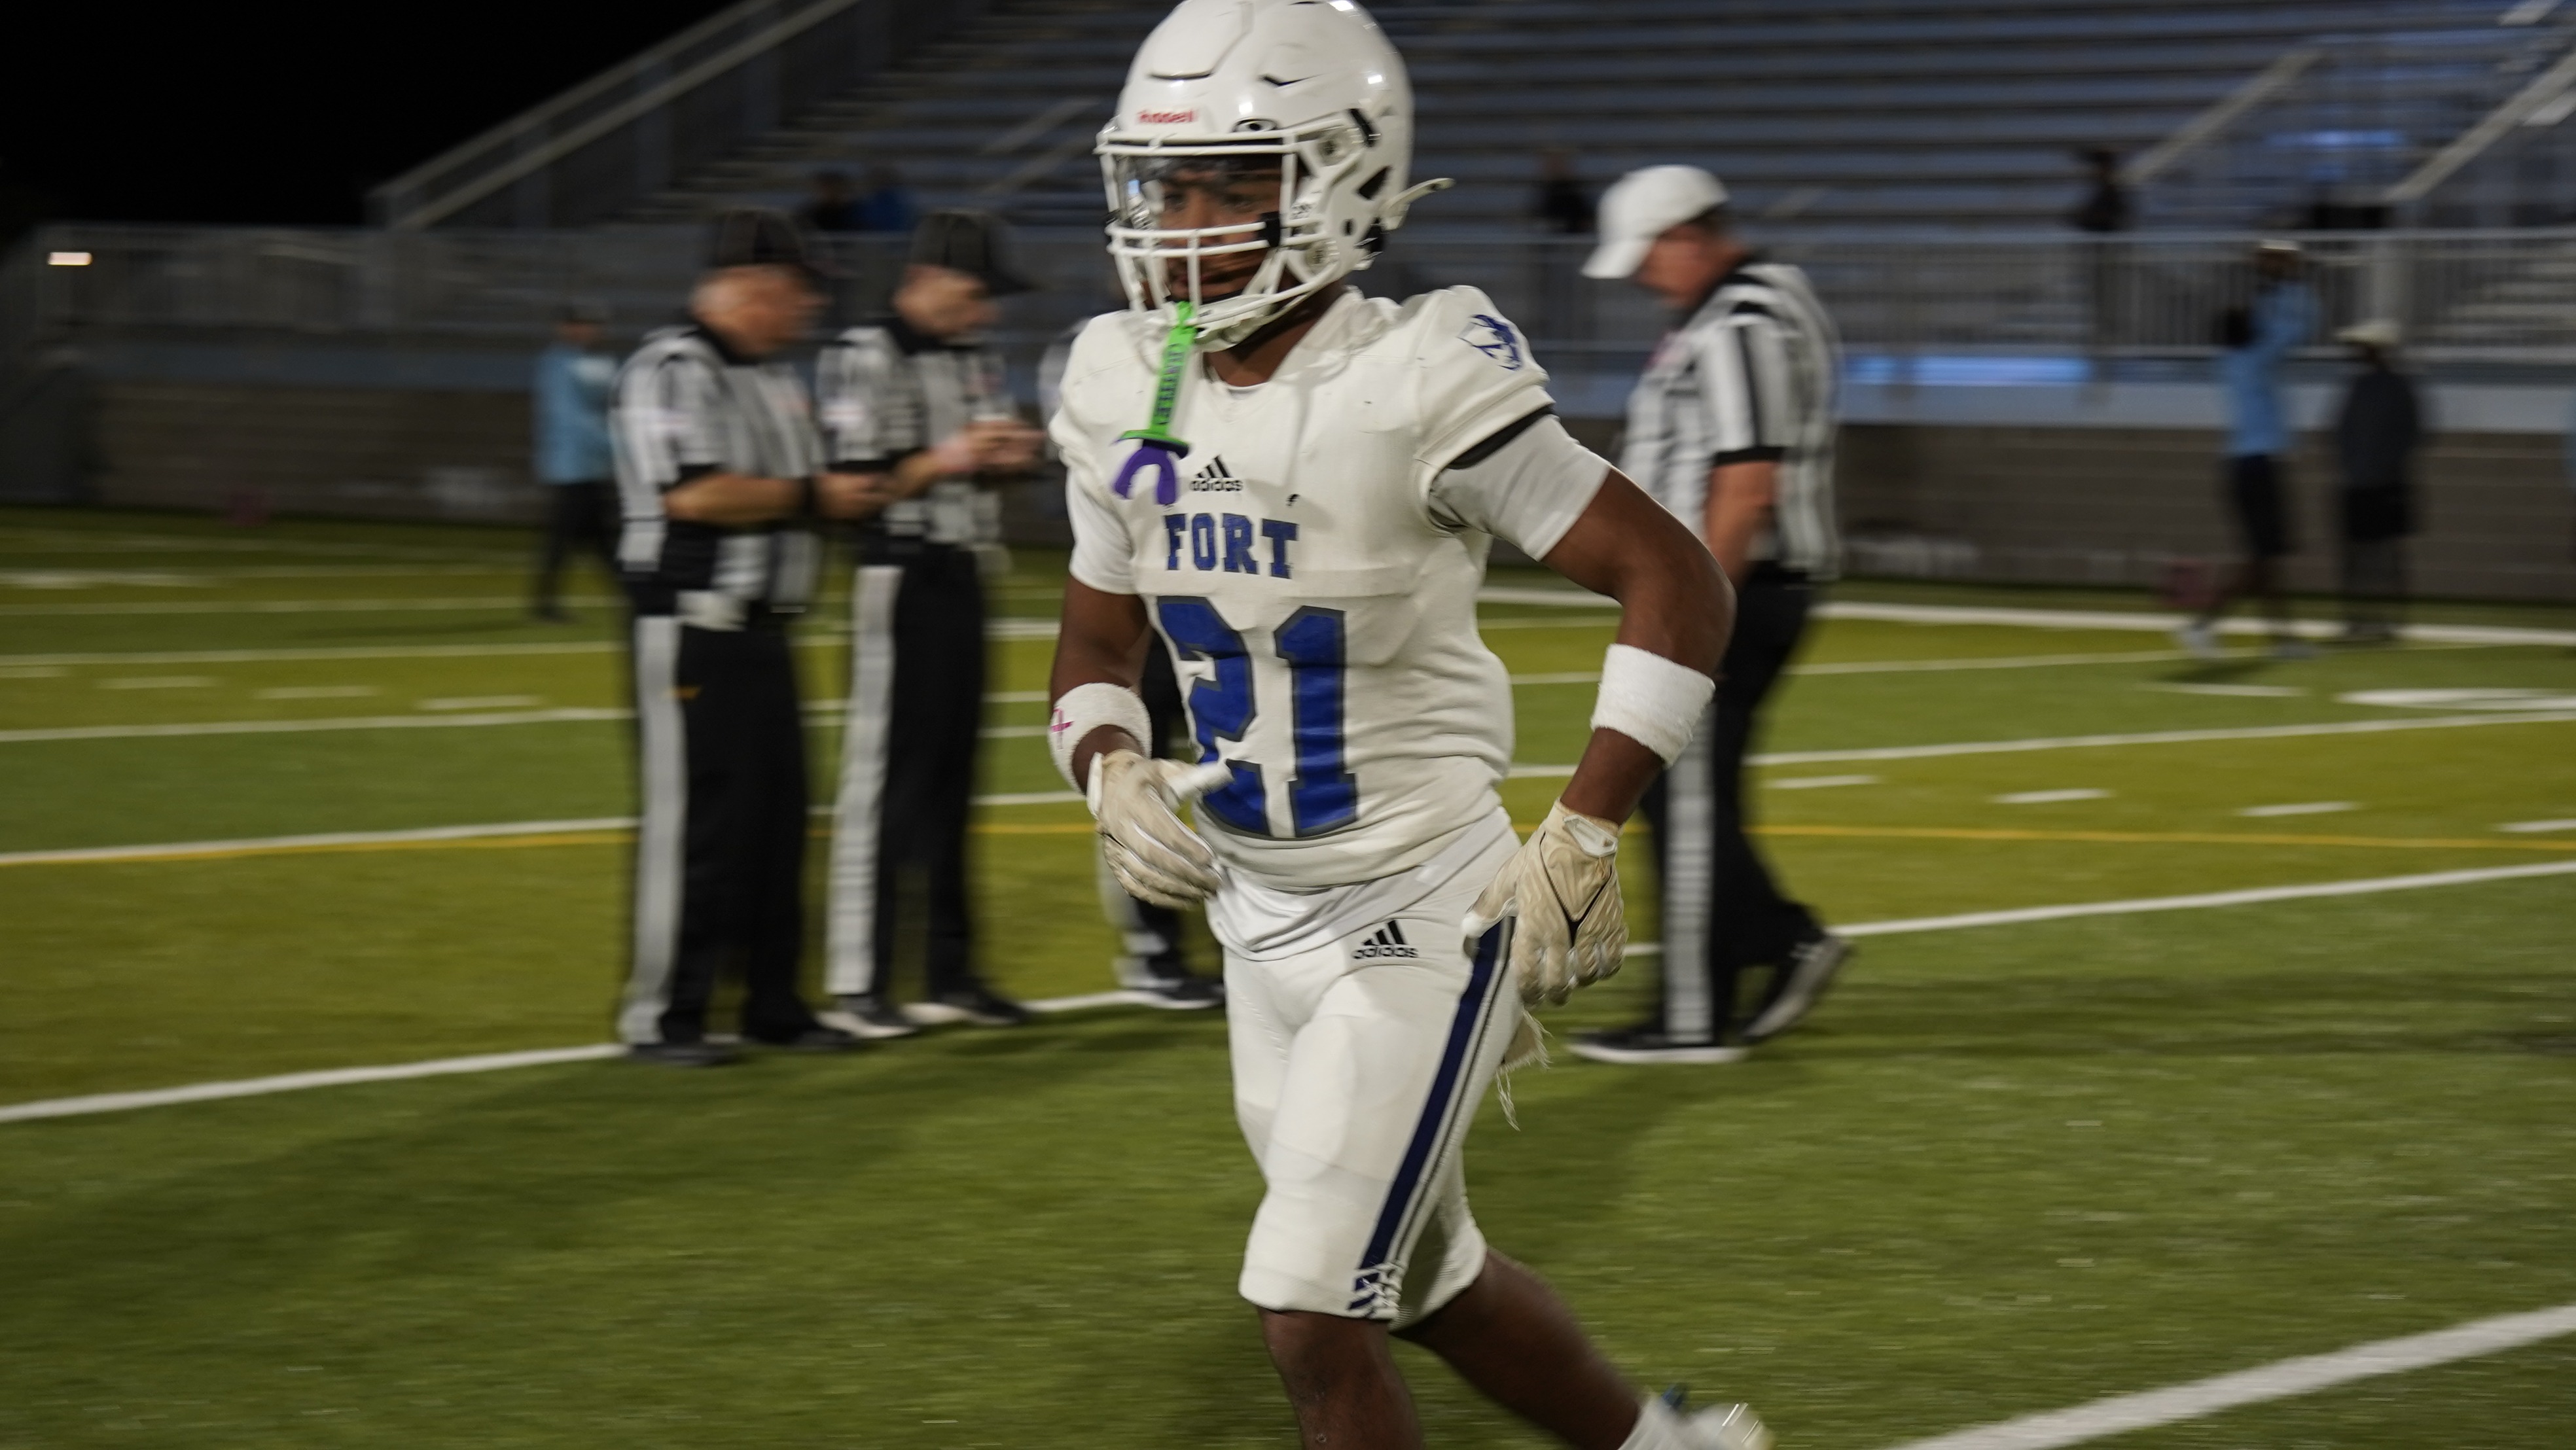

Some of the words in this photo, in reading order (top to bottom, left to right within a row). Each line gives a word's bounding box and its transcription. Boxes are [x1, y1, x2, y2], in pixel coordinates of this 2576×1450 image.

[1163, 512, 1298, 579] FORT
[1157, 595, 1358, 838] 21
[1351, 947, 1419, 959] adidas
